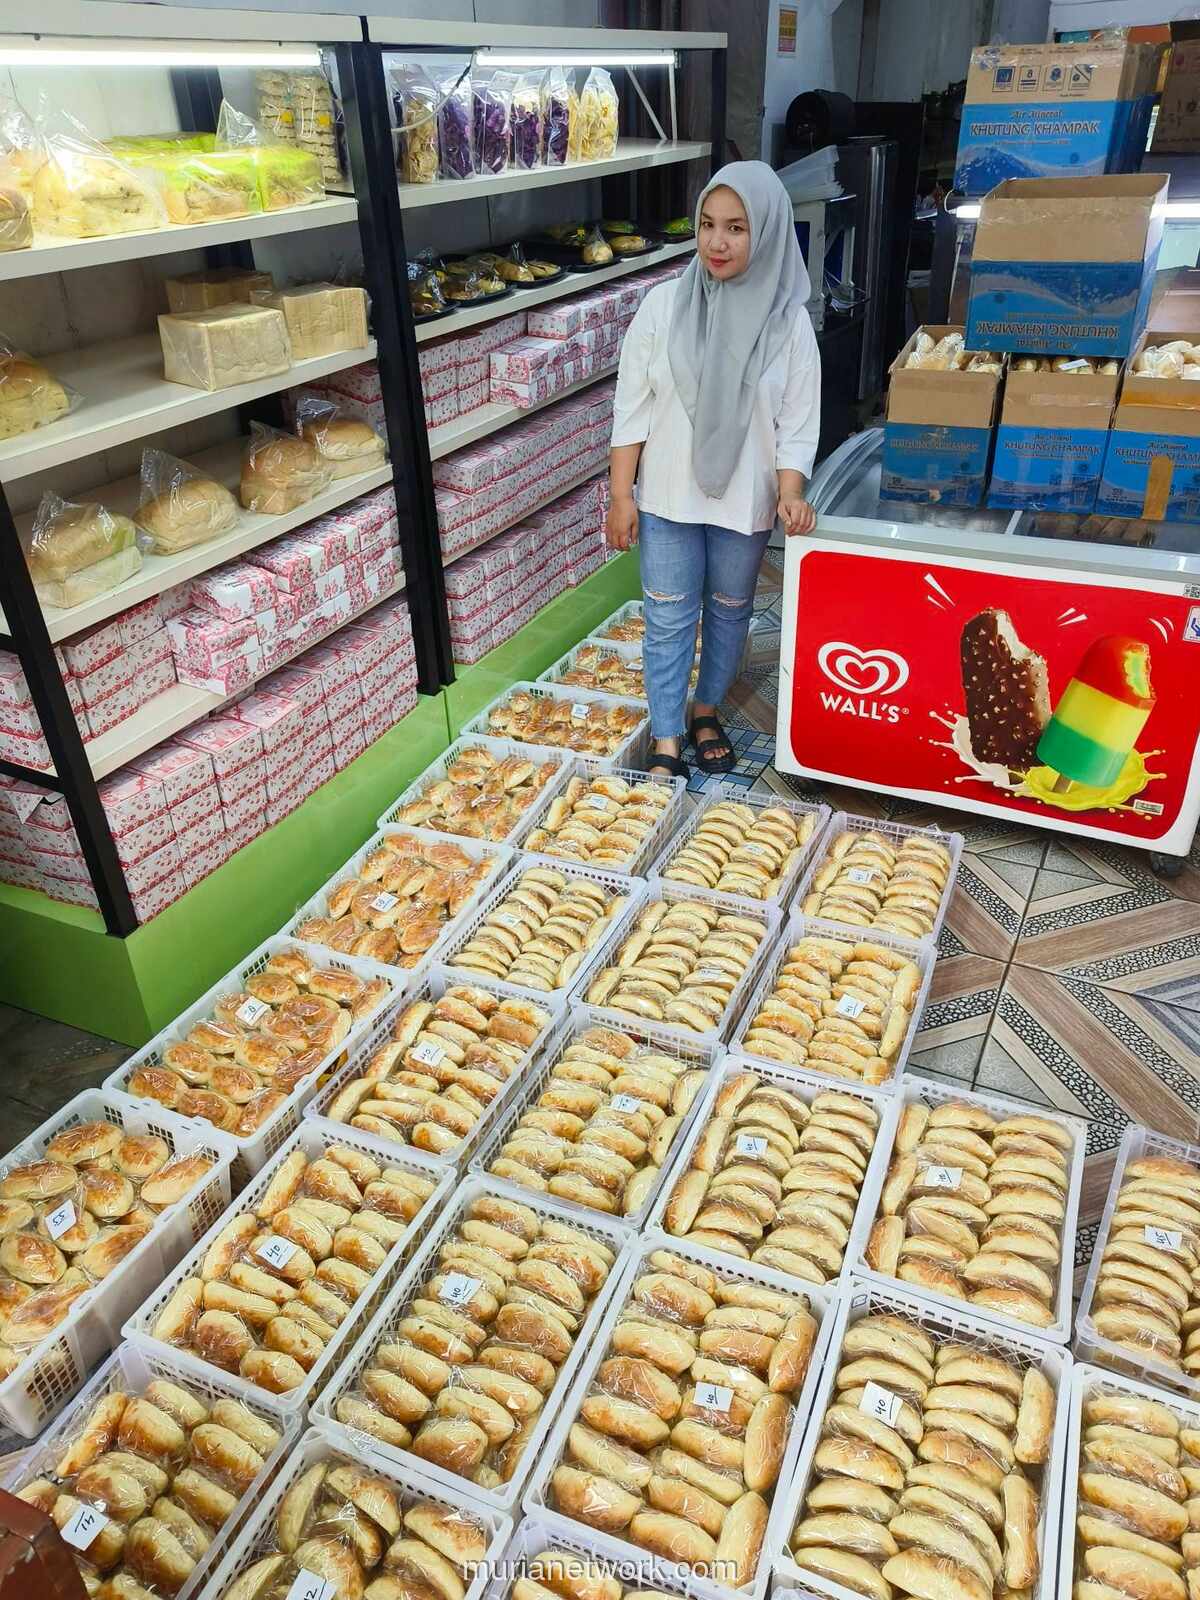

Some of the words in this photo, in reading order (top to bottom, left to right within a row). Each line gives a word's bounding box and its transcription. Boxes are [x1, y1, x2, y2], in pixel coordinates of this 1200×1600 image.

[970, 122, 1031, 136] KHUTUNG
[1034, 120, 1100, 135] KHAMPAK
[820, 692, 900, 723] WALL'S
[266, 1244, 281, 1257] 40
[874, 1399, 886, 1415] 40
